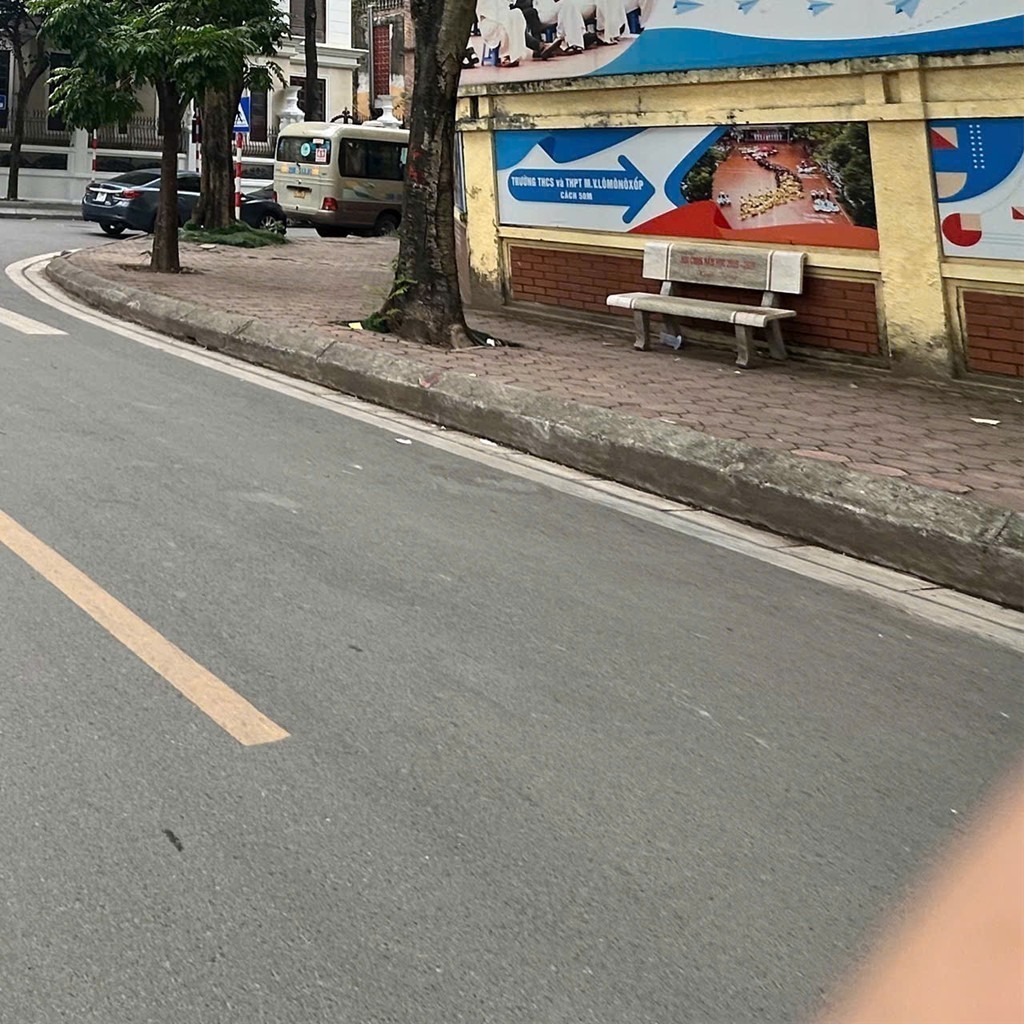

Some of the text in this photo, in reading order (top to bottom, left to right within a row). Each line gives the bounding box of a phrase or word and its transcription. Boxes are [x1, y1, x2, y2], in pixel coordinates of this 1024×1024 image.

[511, 175, 536, 187] TRƯỜNG
[538, 177, 554, 188] THCS
[566, 178, 582, 189] THPT
[560, 190, 577, 200] CÁCH
